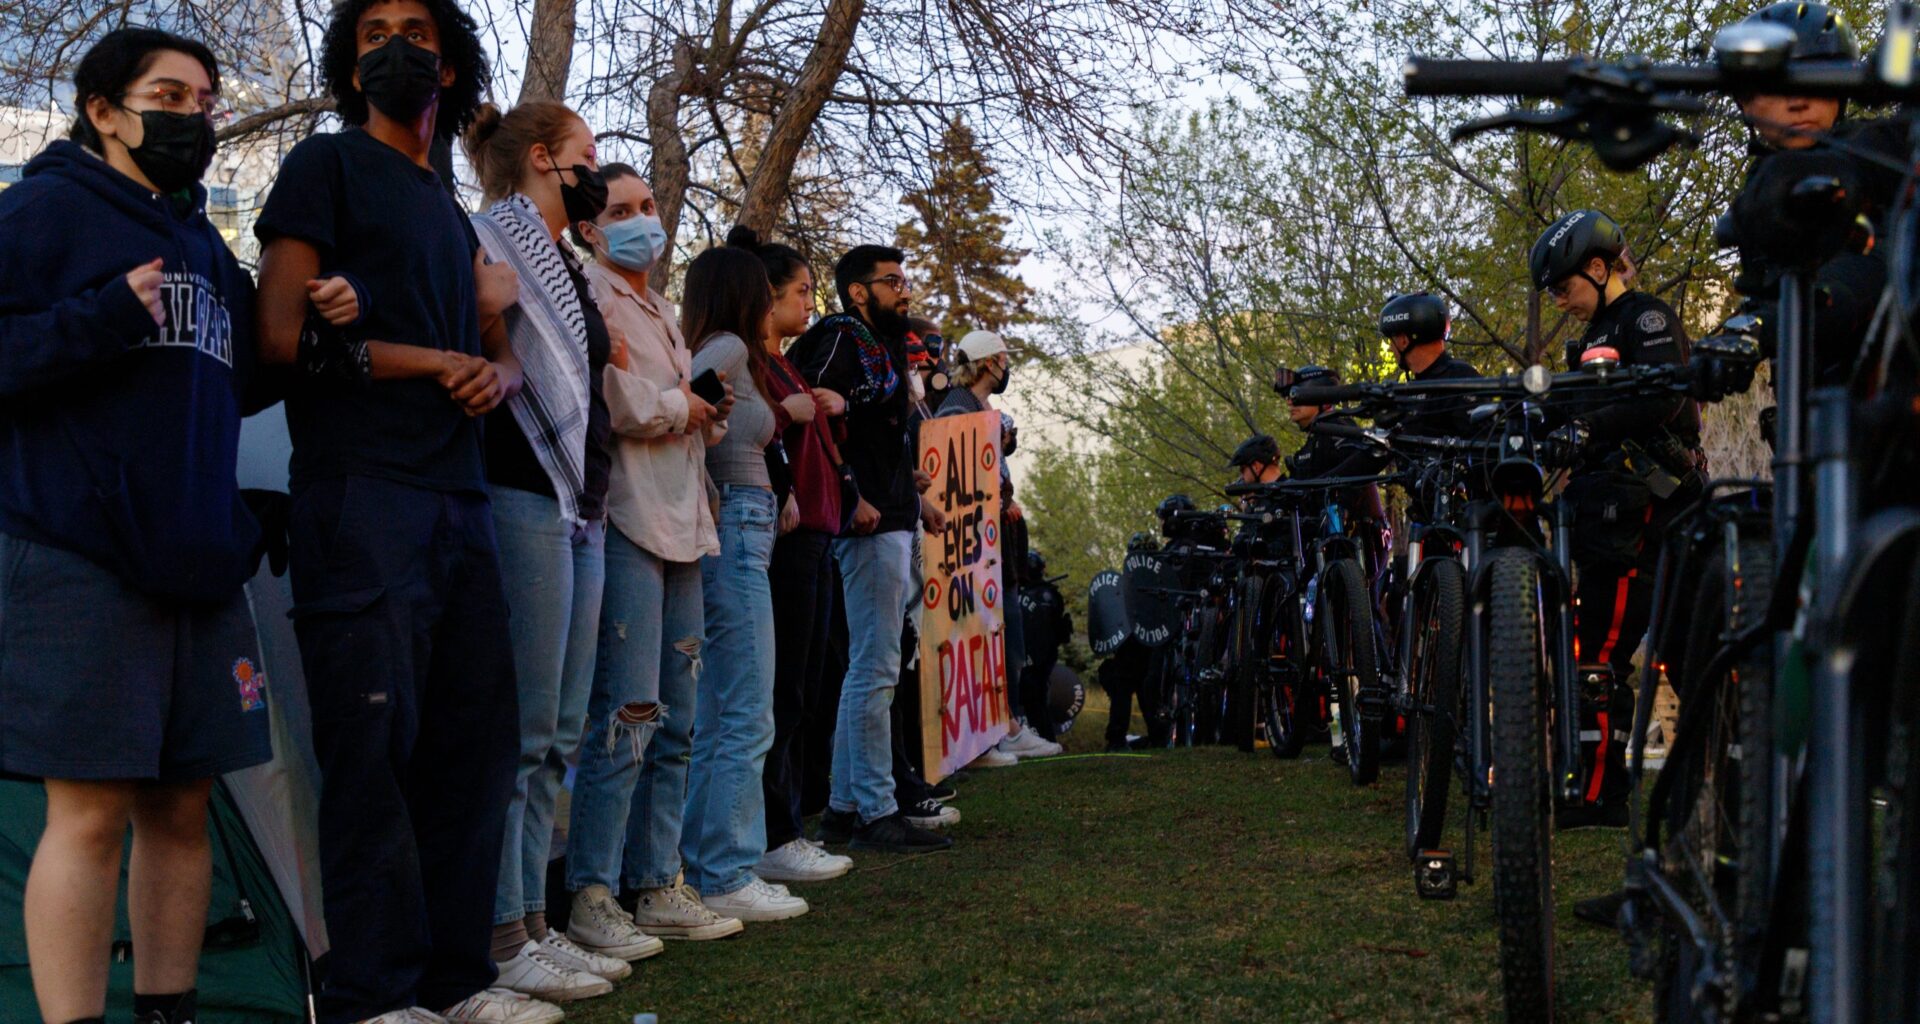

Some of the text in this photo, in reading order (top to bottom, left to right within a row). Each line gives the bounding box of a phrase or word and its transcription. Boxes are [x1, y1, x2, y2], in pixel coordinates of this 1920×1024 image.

[1548, 212, 1585, 247] POLICE
[1382, 312, 1410, 323] POLICE
[945, 427, 985, 512] ALL
[944, 504, 984, 573] EYES
[1126, 554, 1163, 574] POLICE
[948, 571, 975, 622] ON
[1090, 573, 1120, 597] POLICE
[1133, 622, 1170, 643] POLICE
[938, 631, 1008, 757] RAFAH
